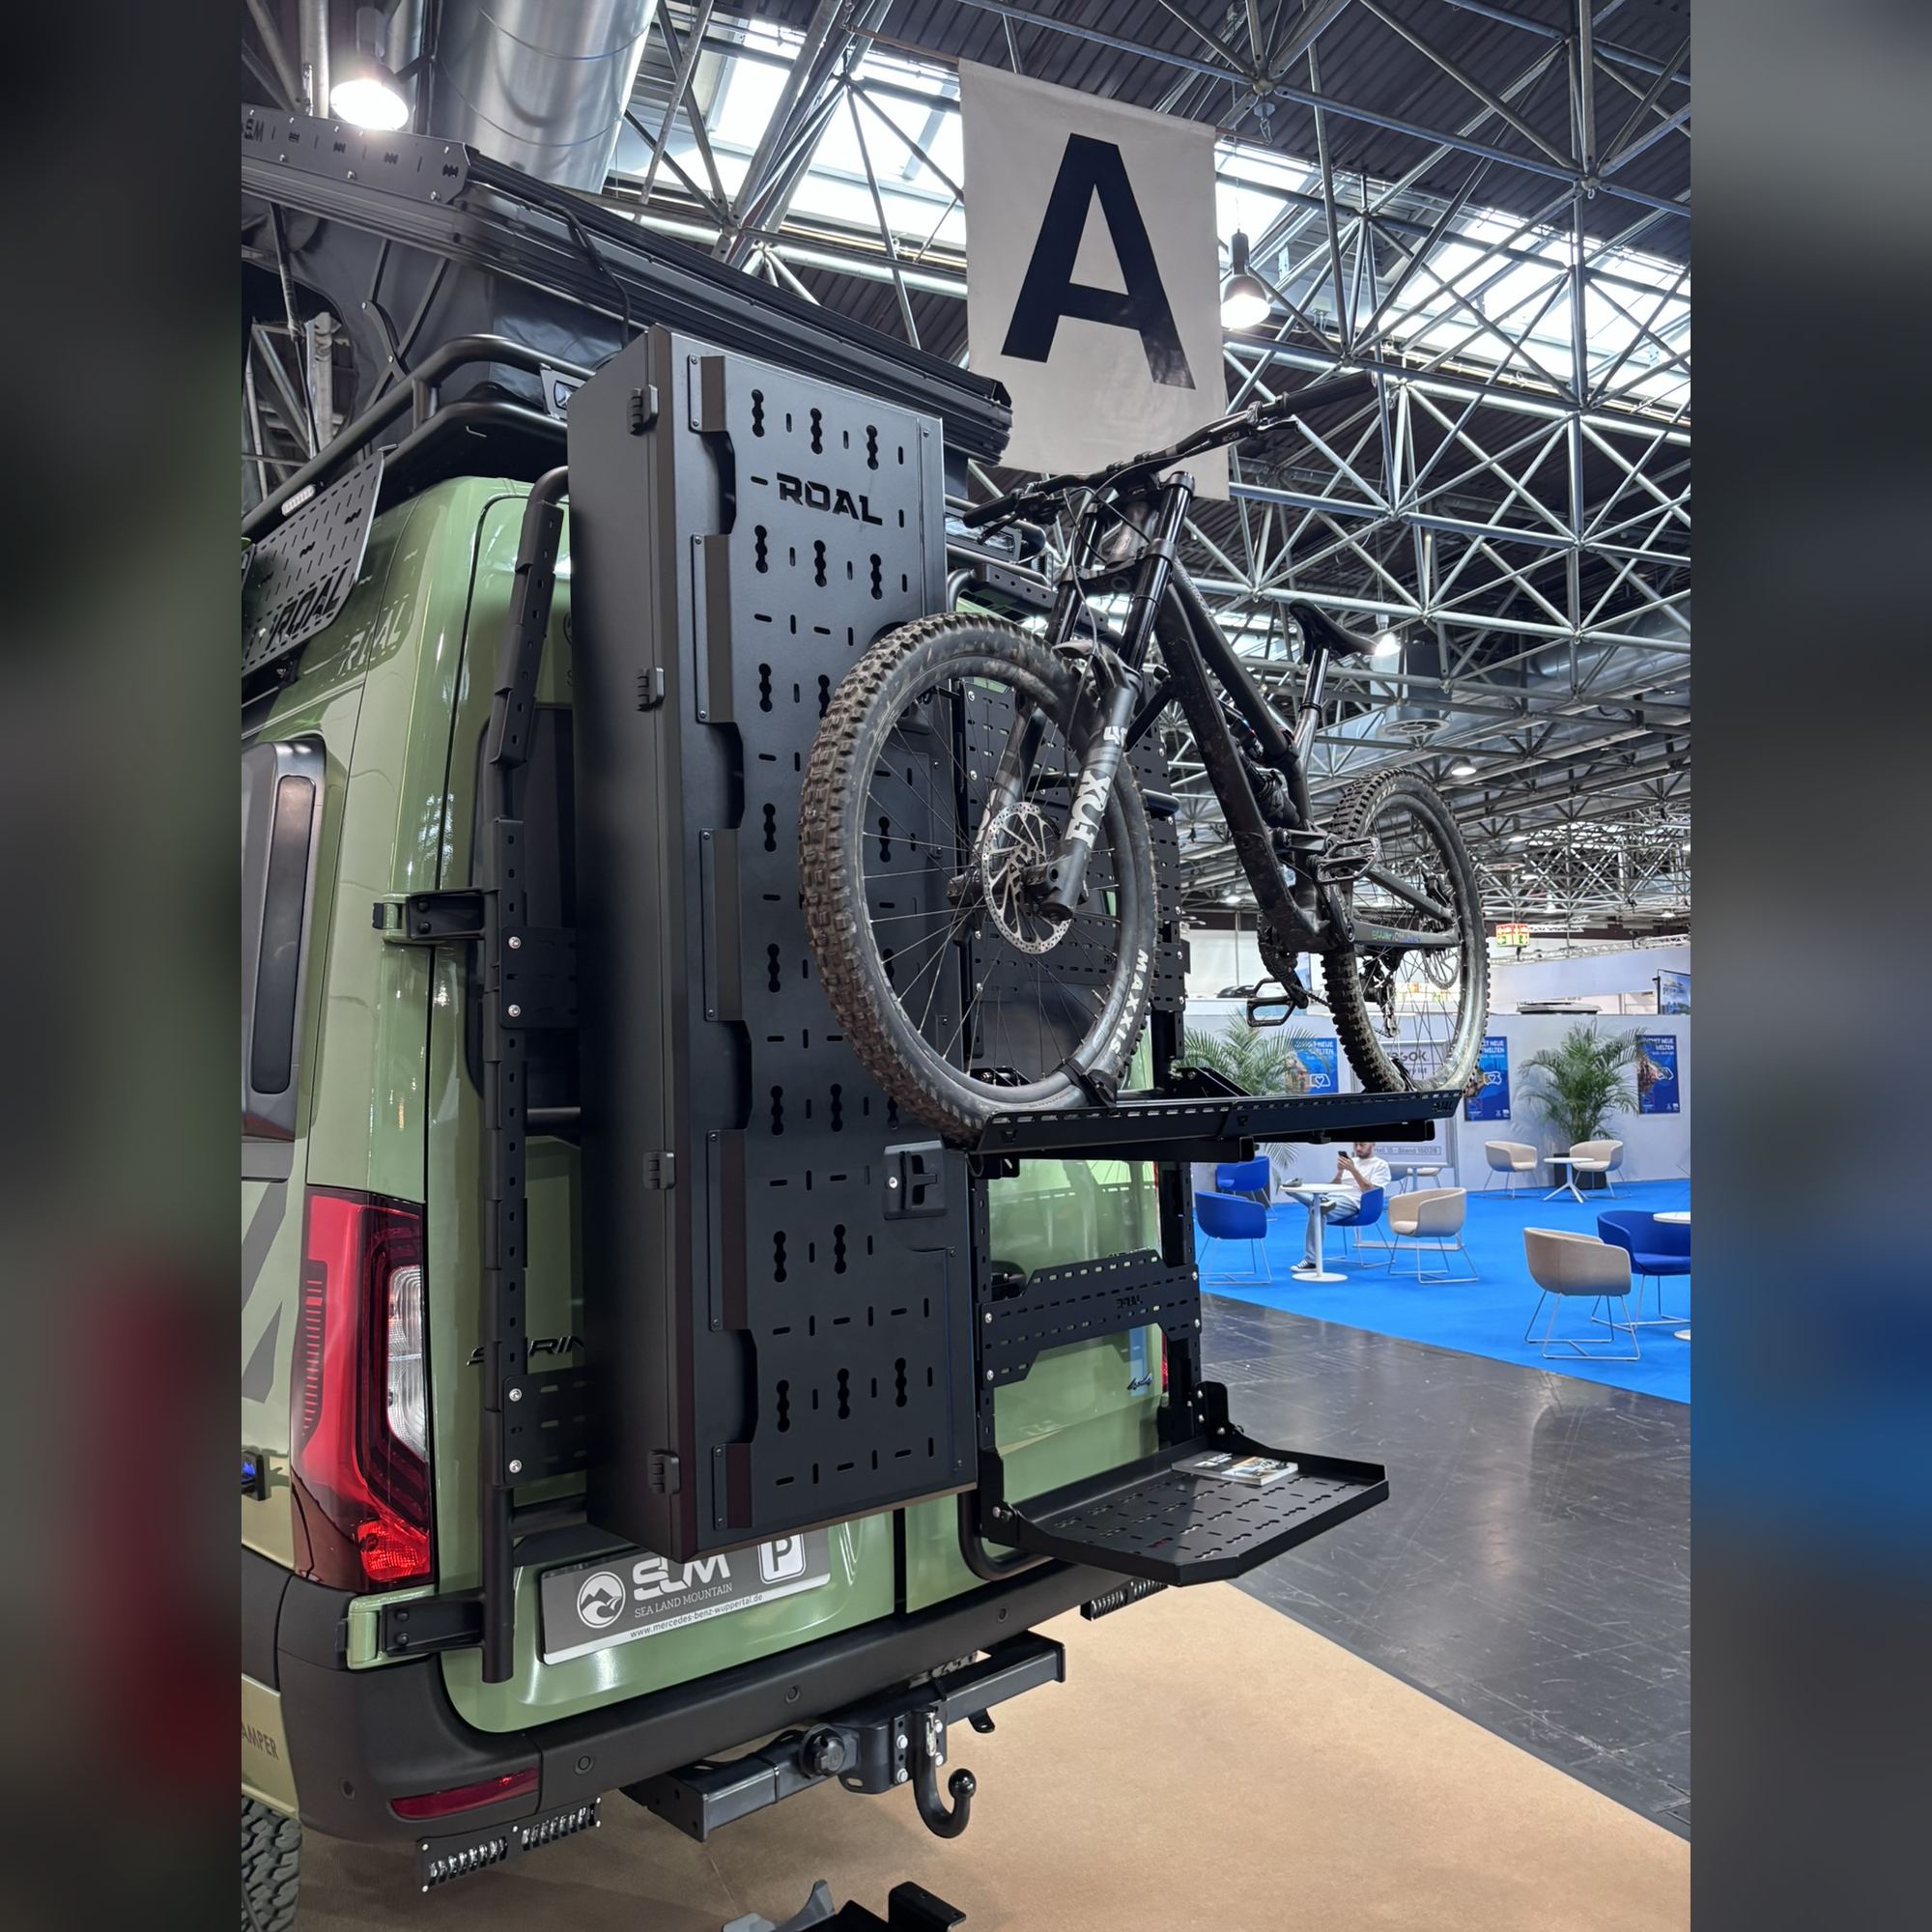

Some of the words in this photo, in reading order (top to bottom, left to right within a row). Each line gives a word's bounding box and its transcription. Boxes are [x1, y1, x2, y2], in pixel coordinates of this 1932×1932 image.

[1001, 132, 1196, 389] A
[776, 471, 883, 526] ROAL
[1065, 770, 1111, 850] FOX
[1109, 949, 1150, 1054] MAXXIS
[629, 1592, 763, 1639] www.mercedes-benz-wuppertal.de
[634, 1602, 654, 1618] SEA
[655, 1596, 682, 1613] LAND
[681, 1582, 734, 1606] MOUNTAIN
